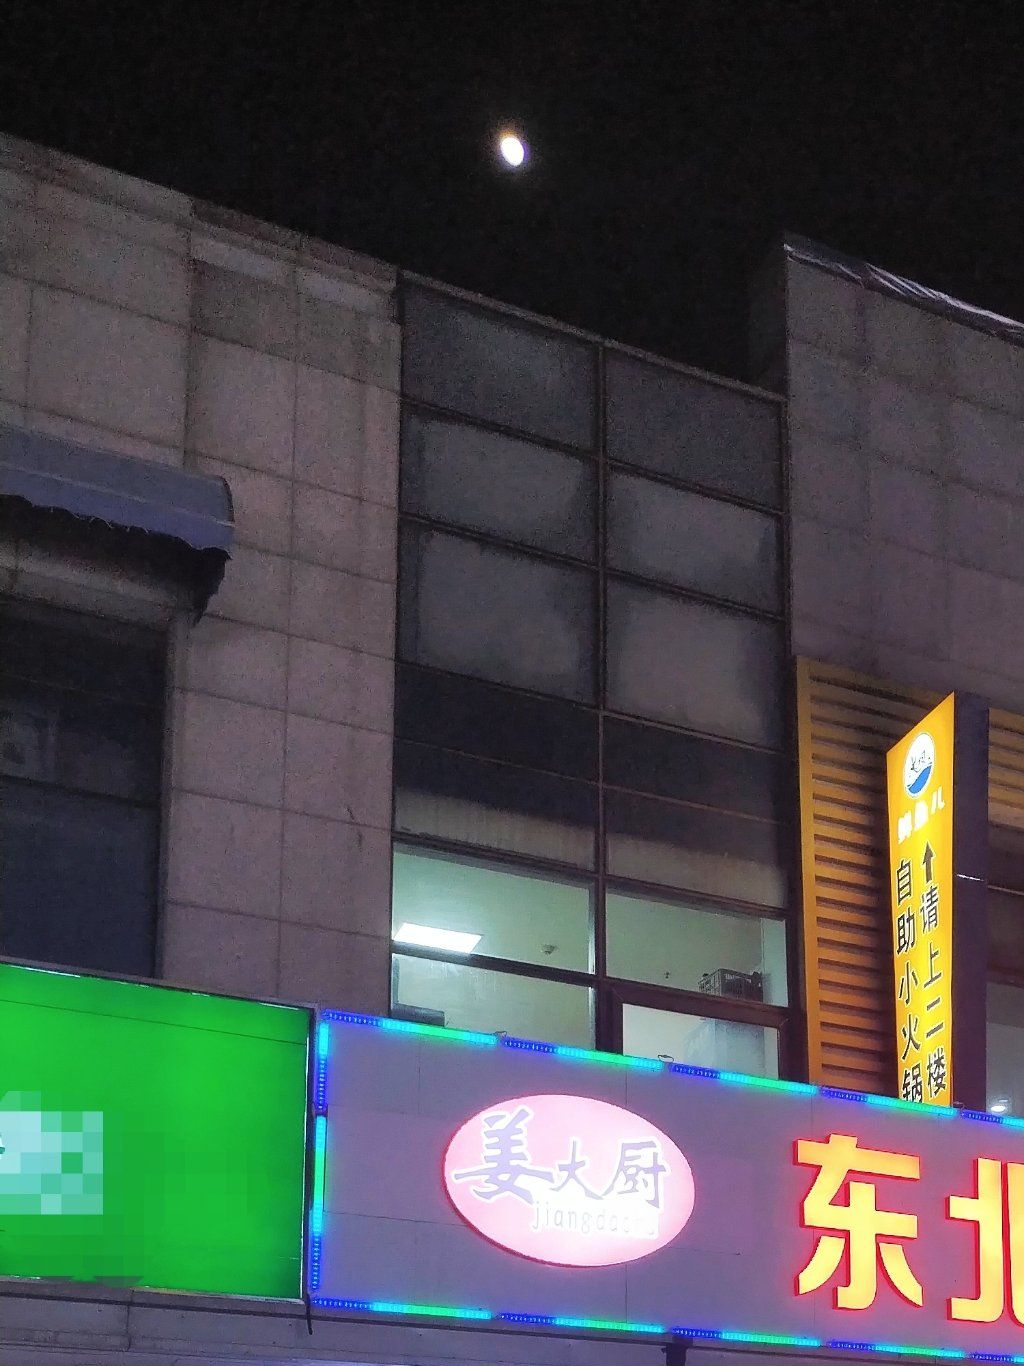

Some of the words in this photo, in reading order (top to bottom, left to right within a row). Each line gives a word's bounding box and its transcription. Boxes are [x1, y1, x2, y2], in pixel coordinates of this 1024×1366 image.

[896, 859, 923, 1103] 自助小火锅
[920, 885, 947, 1098] 请上二楼
[454, 1109, 667, 1209] 姜大厨
